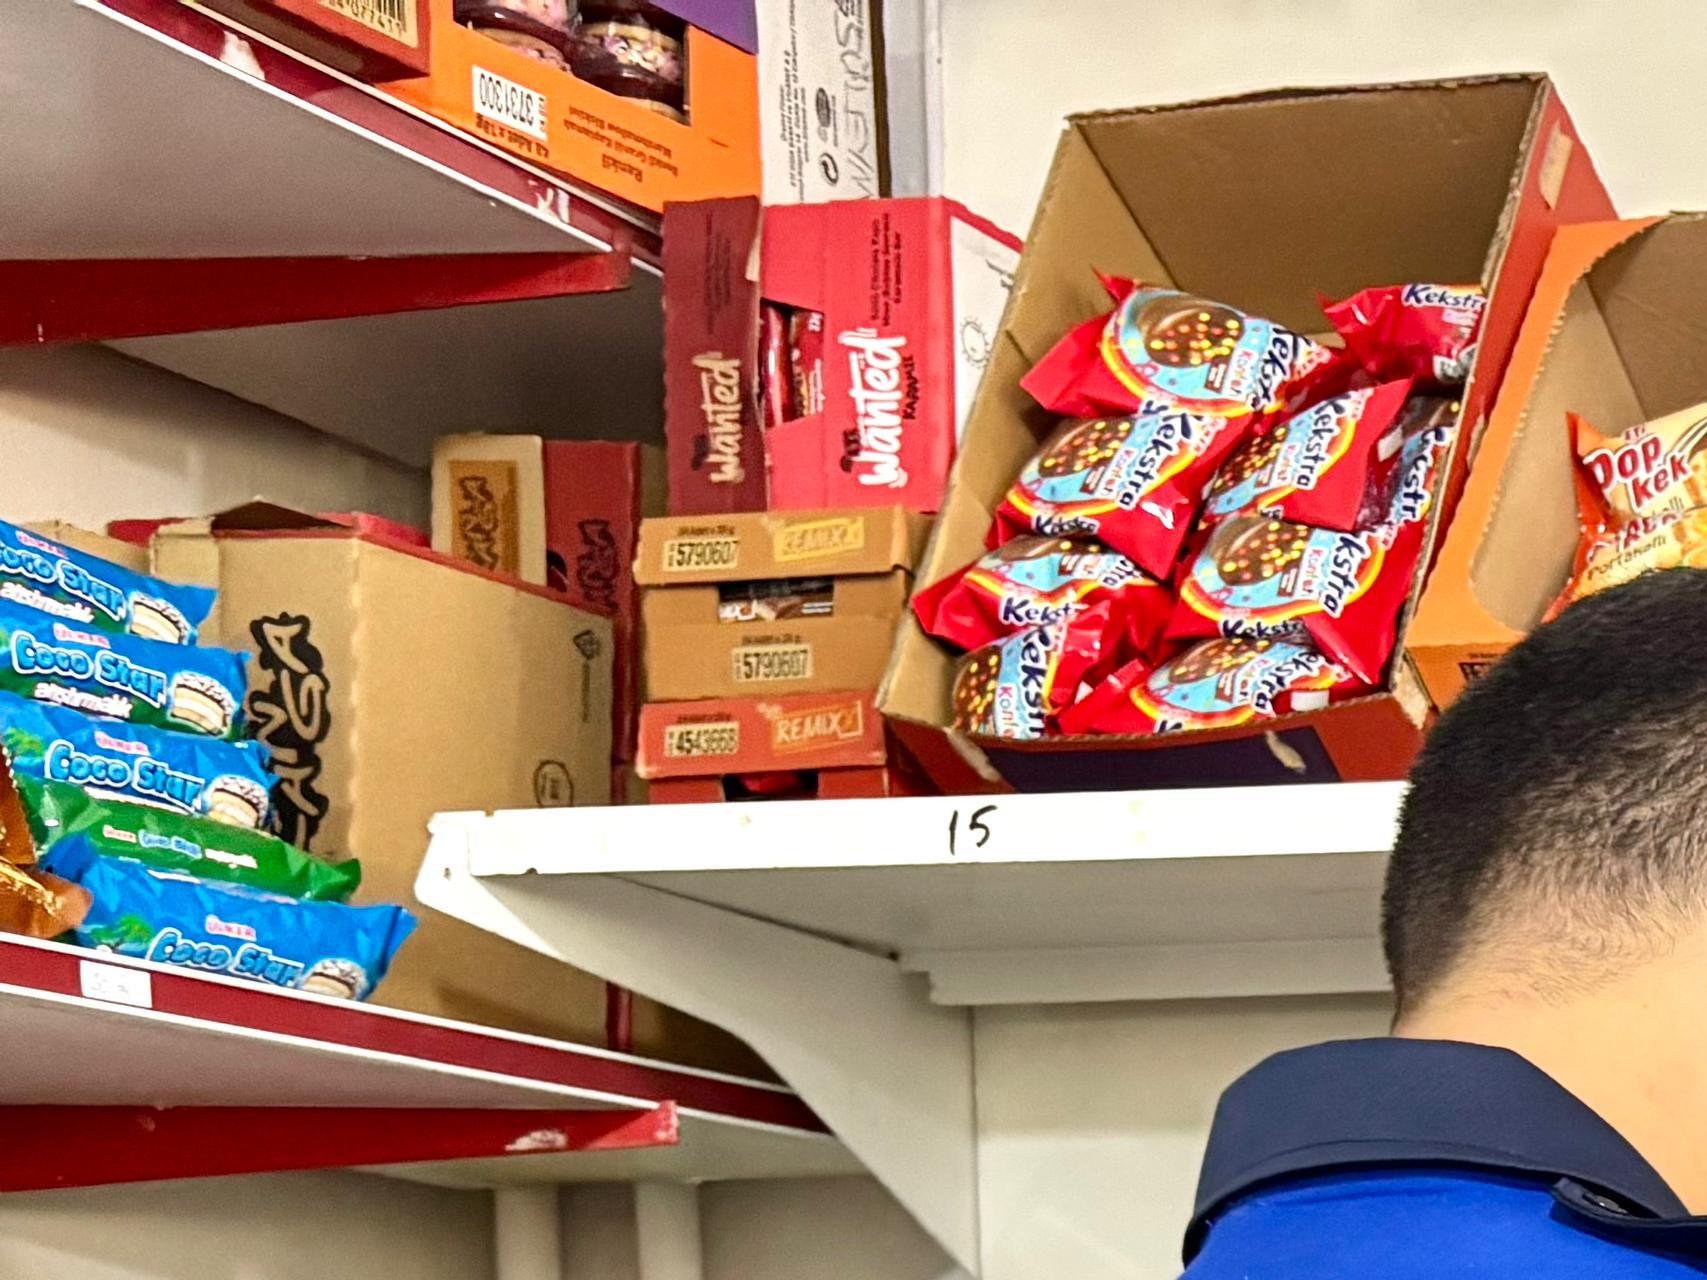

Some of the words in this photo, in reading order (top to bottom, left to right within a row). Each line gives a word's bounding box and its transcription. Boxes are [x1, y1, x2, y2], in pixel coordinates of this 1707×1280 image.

[1118, 409, 1202, 510] Kekstra
[1628, 453, 1690, 513] kek
[0, 545, 56, 582] oco
[97, 653, 167, 706] Star
[134, 760, 204, 814] Star
[949, 805, 998, 855] 15
